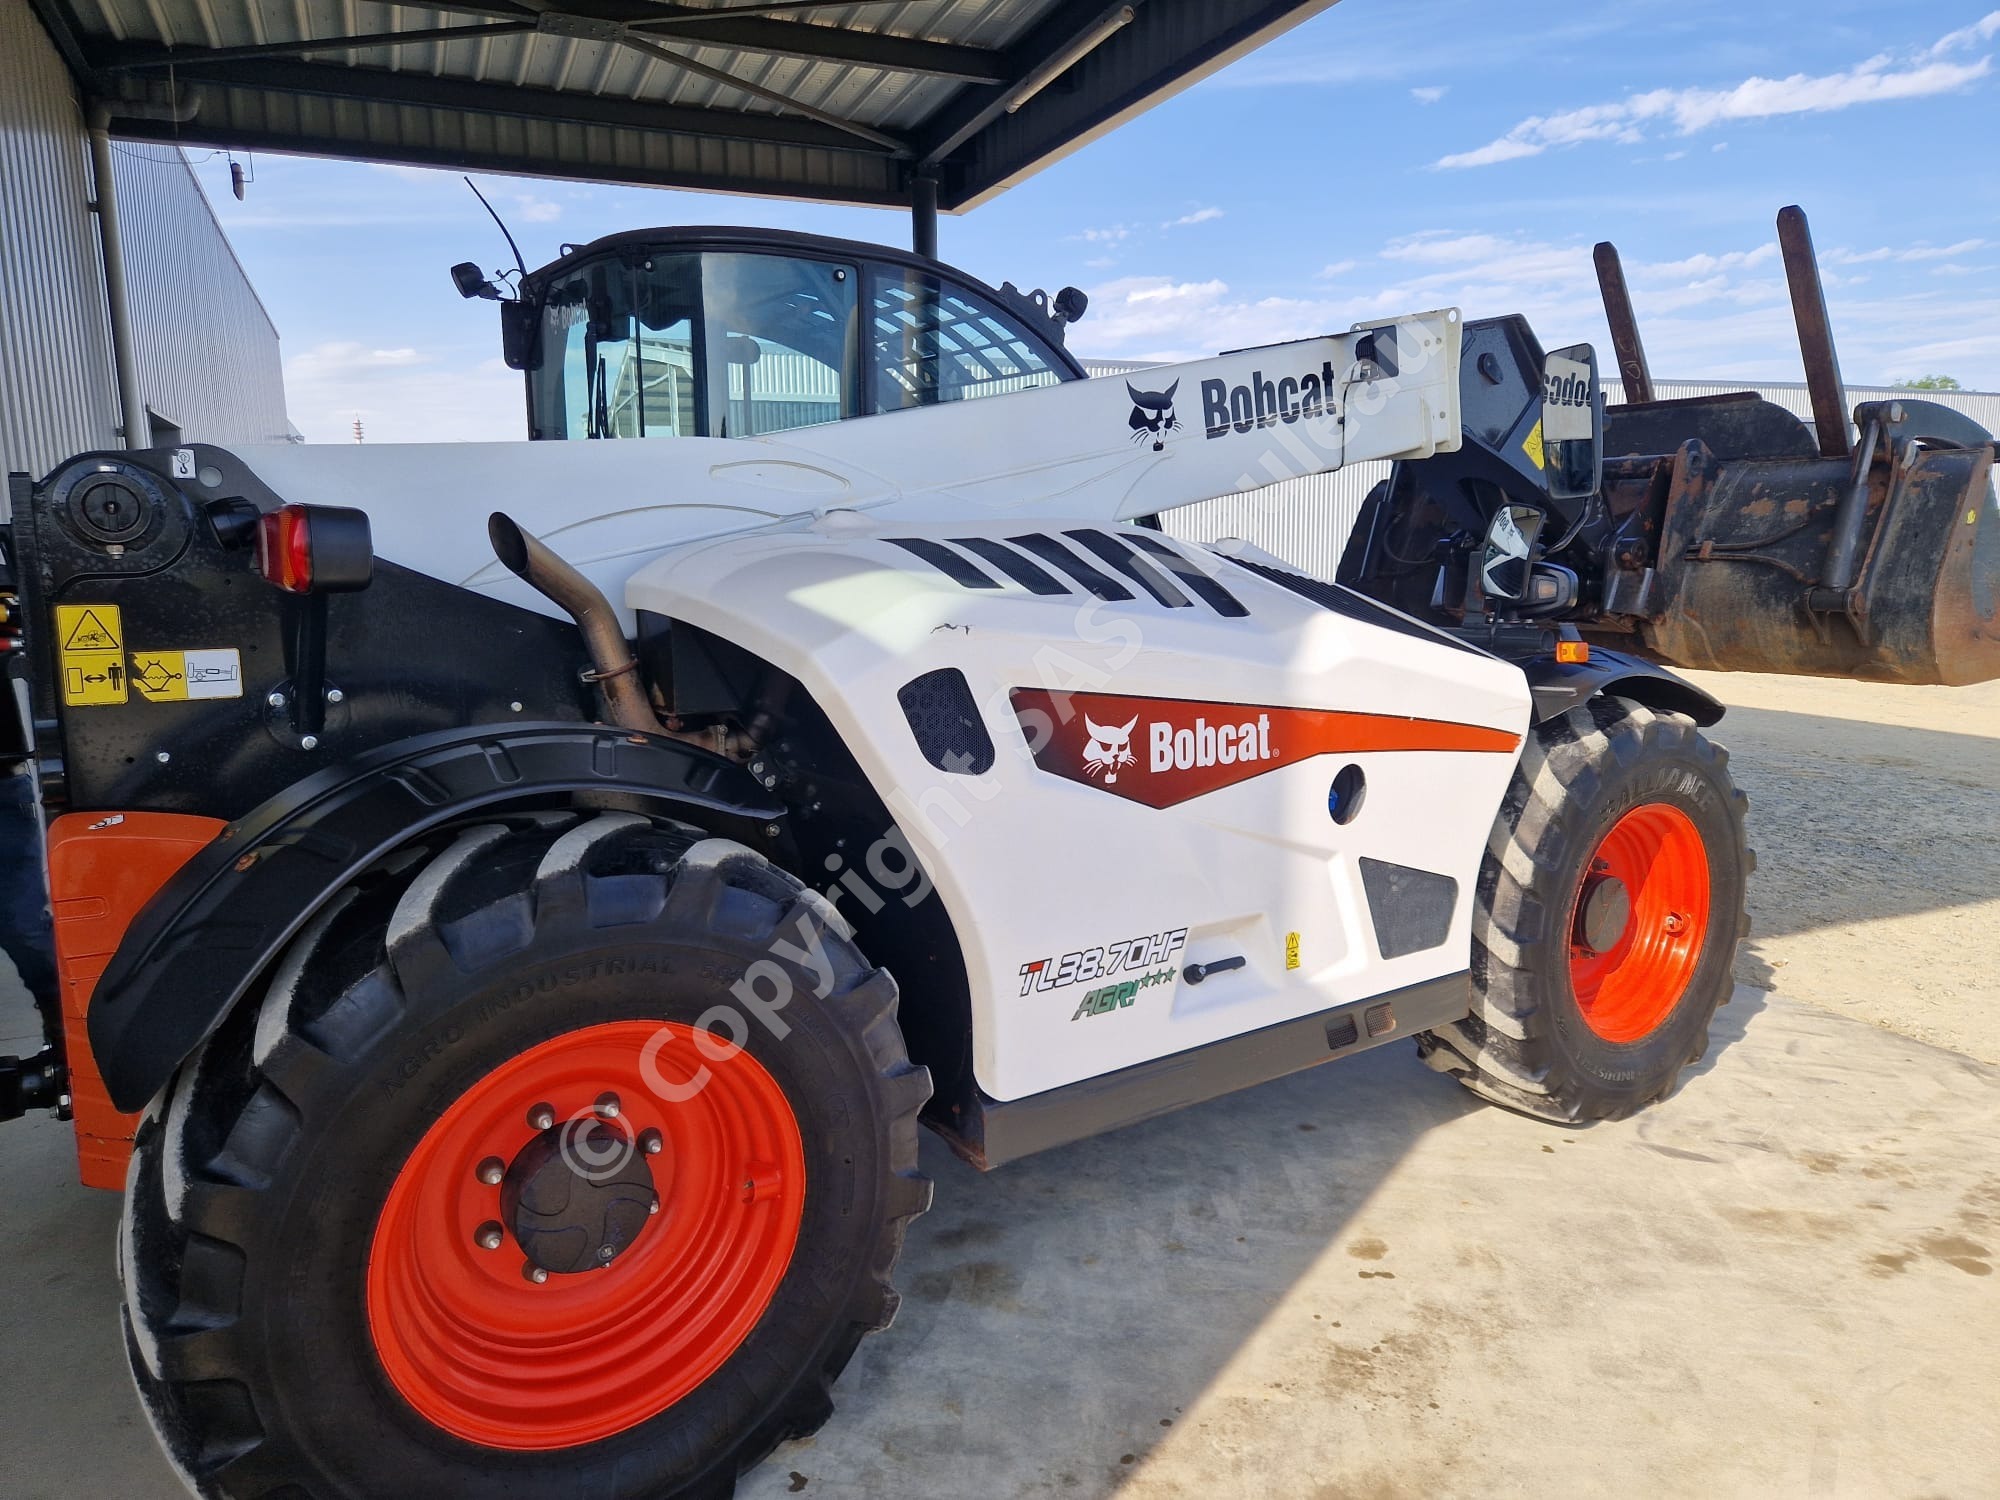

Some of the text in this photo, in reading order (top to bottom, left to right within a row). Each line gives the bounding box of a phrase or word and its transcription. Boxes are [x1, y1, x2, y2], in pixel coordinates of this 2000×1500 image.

[1200, 361, 1337, 440] Bobcat
[1149, 713, 1271, 773] Bobcat
[1018, 926, 1189, 998] TL38.70HF
